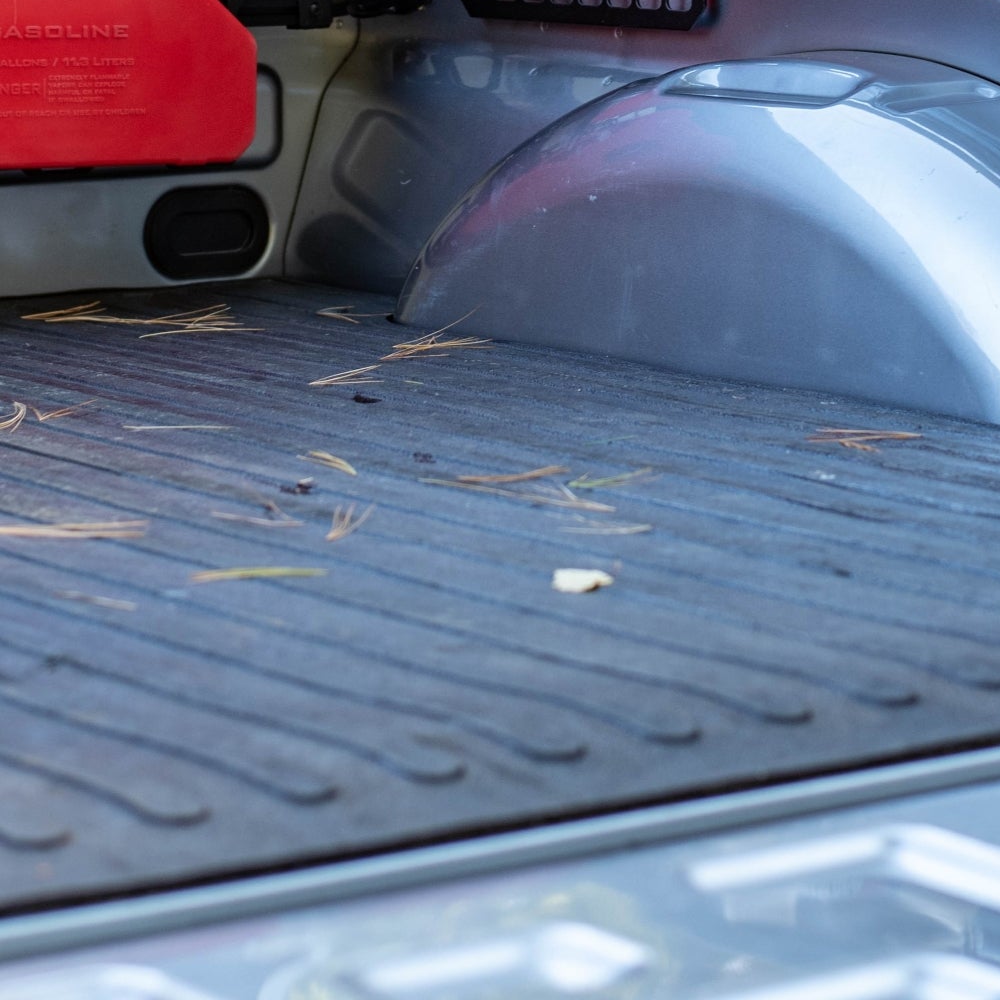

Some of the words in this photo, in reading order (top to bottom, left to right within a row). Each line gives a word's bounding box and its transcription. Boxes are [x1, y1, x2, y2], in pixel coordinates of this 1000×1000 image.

[0, 24, 129, 39] ASOLINE
[0, 57, 48, 67] ALLONS
[92, 56, 136, 66] LITERS
[0, 82, 41, 95] NGER
